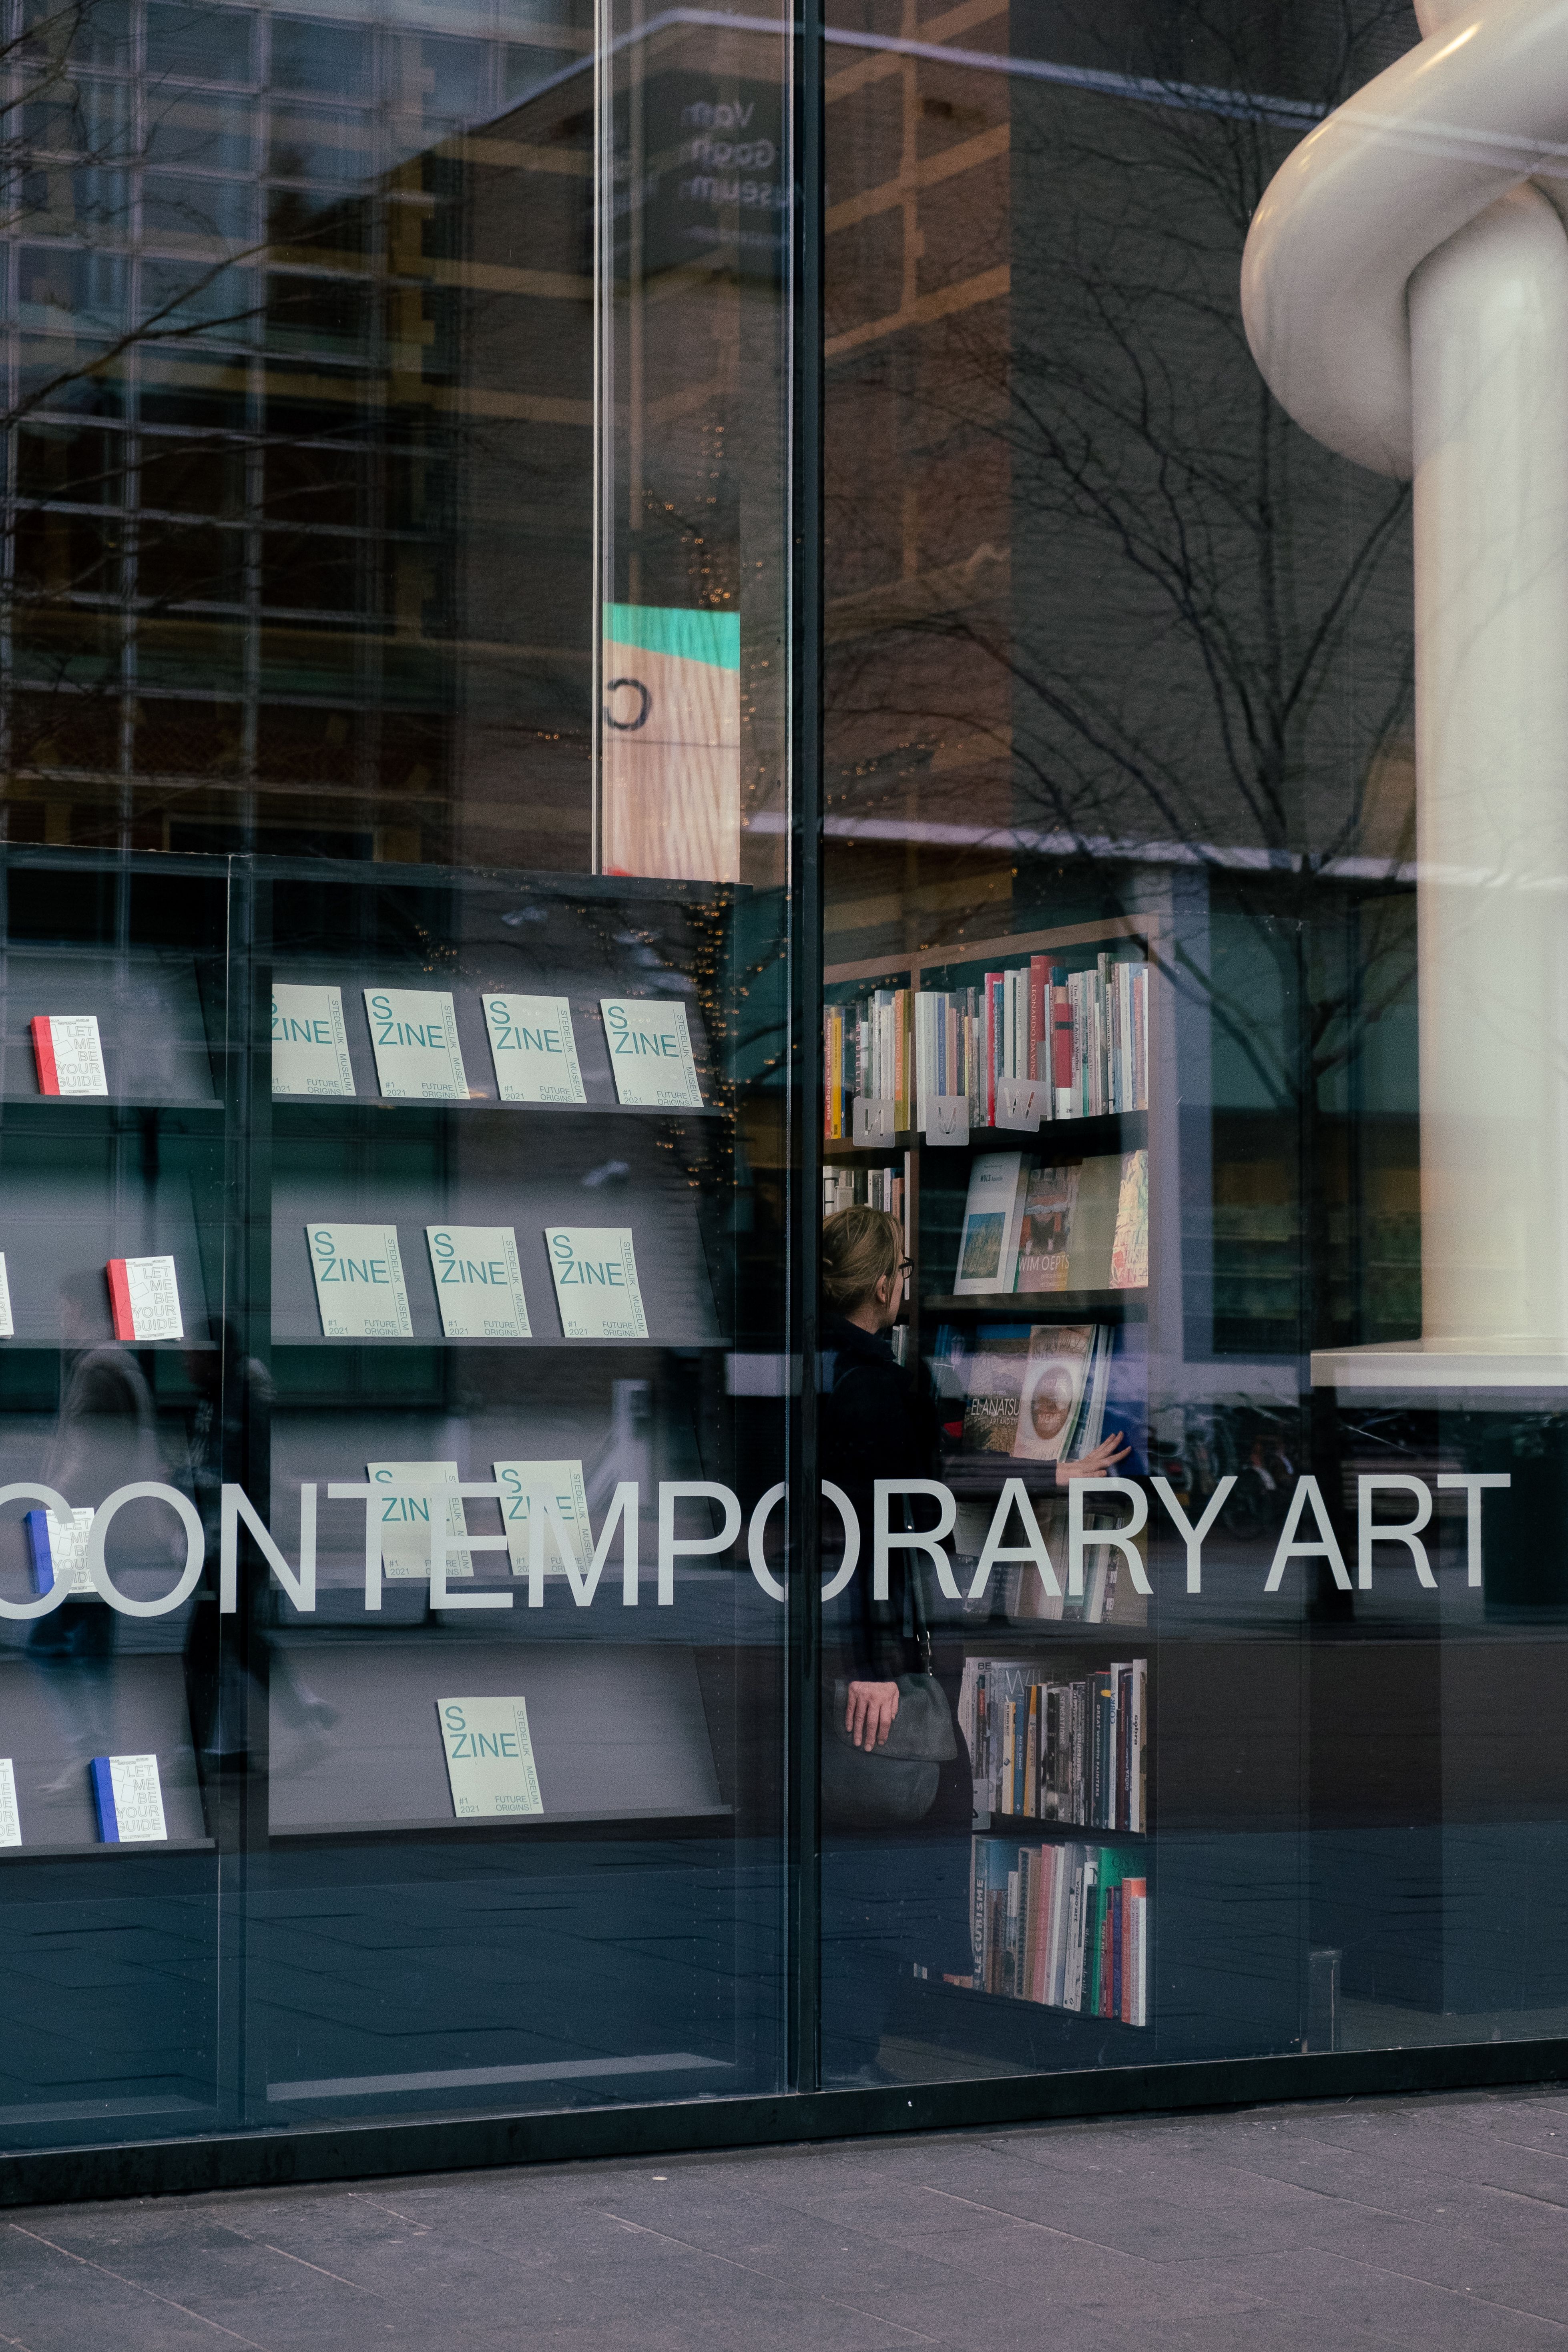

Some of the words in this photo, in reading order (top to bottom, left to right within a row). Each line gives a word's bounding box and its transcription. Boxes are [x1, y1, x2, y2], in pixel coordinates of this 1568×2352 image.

[371, 996, 393, 1019] S
[490, 1001, 510, 1024] S
[608, 1006, 628, 1029] S
[1074, 1018, 1079, 1026] of
[67, 1026, 93, 1037] LET
[376, 1022, 446, 1048] ZINE
[74, 1038, 96, 1049] ME
[330, 1000, 346, 1044] STEDELIJK
[340, 1054, 353, 1089] MUSEUM
[494, 1027, 563, 1052] ZINE
[612, 1032, 679, 1057] ZINE
[1031, 1039, 1037, 1053] DA
[443, 1005, 458, 1048] STEDELIJK
[454, 1058, 467, 1093] MUSEUM
[560, 1010, 574, 1052] STEDELIJK
[571, 1063, 583, 1097] MUSEUM
[78, 1051, 98, 1062] BE
[677, 1015, 690, 1057] STEDELIJK
[687, 1067, 699, 1100] MUSEUM
[56, 1063, 100, 1074] YOUR
[55, 1076, 102, 1087] GUIDE
[307, 1079, 339, 1087] FUTURE
[422, 1083, 453, 1091] FUTURE
[307, 1086, 341, 1095] ORIGINS
[422, 1090, 456, 1099] ORIGINS
[540, 1086, 571, 1094] FUTURE
[657, 1091, 687, 1099] FUTURE
[540, 1094, 573, 1102] ORIGINS
[657, 1098, 689, 1107] ORIGINS
[314, 1231, 335, 1256] S
[434, 1233, 454, 1257] S
[553, 1234, 573, 1258] S
[1019, 1256, 1040, 1272] WIM
[1041, 1254, 1070, 1271] OEPTS
[143, 1266, 170, 1278] LET
[319, 1258, 390, 1284] ZINE
[438, 1260, 508, 1284] ZINE
[558, 1261, 625, 1286] ZINE
[150, 1279, 173, 1291] ME
[387, 1238, 402, 1283] STEDELIJK
[398, 1293, 411, 1329] MUSEUM
[506, 1240, 520, 1284] STEDELIJK
[516, 1294, 528, 1330] MUSEUM
[623, 1241, 636, 1285] STEDELIJK
[633, 1295, 645, 1331] MUSEUM
[154, 1292, 174, 1304] BE
[132, 1305, 176, 1318] YOUR
[130, 1318, 177, 1331] GUIDE
[364, 1320, 397, 1328] FUTURE
[484, 1320, 516, 1329] FUTURE
[365, 1328, 400, 1336] ORIGINS
[484, 1329, 518, 1337] ORIGINS
[972, 1398, 980, 1416] EL
[502, 1469, 522, 1493] S
[573, 1473, 586, 1519] STEDELIJK
[0, 1475, 1238, 1619] CONTEMPORARY
[1264, 1473, 1511, 1592] ART
[390, 1568, 410, 1576] 2021
[445, 1706, 466, 1731] S
[450, 1733, 519, 1758] ZINE
[517, 1710, 530, 1756] STEDELIJK
[527, 1766, 539, 1804] MUSEUM
[126, 1765, 153, 1777] LET
[133, 1778, 155, 1790] ME
[137, 1792, 157, 1804] BE
[115, 1805, 159, 1819] YOUR
[461, 1805, 479, 1813] 2021
[975, 1879, 984, 1952] CUBISME
[974, 1956, 982, 1973] LE
